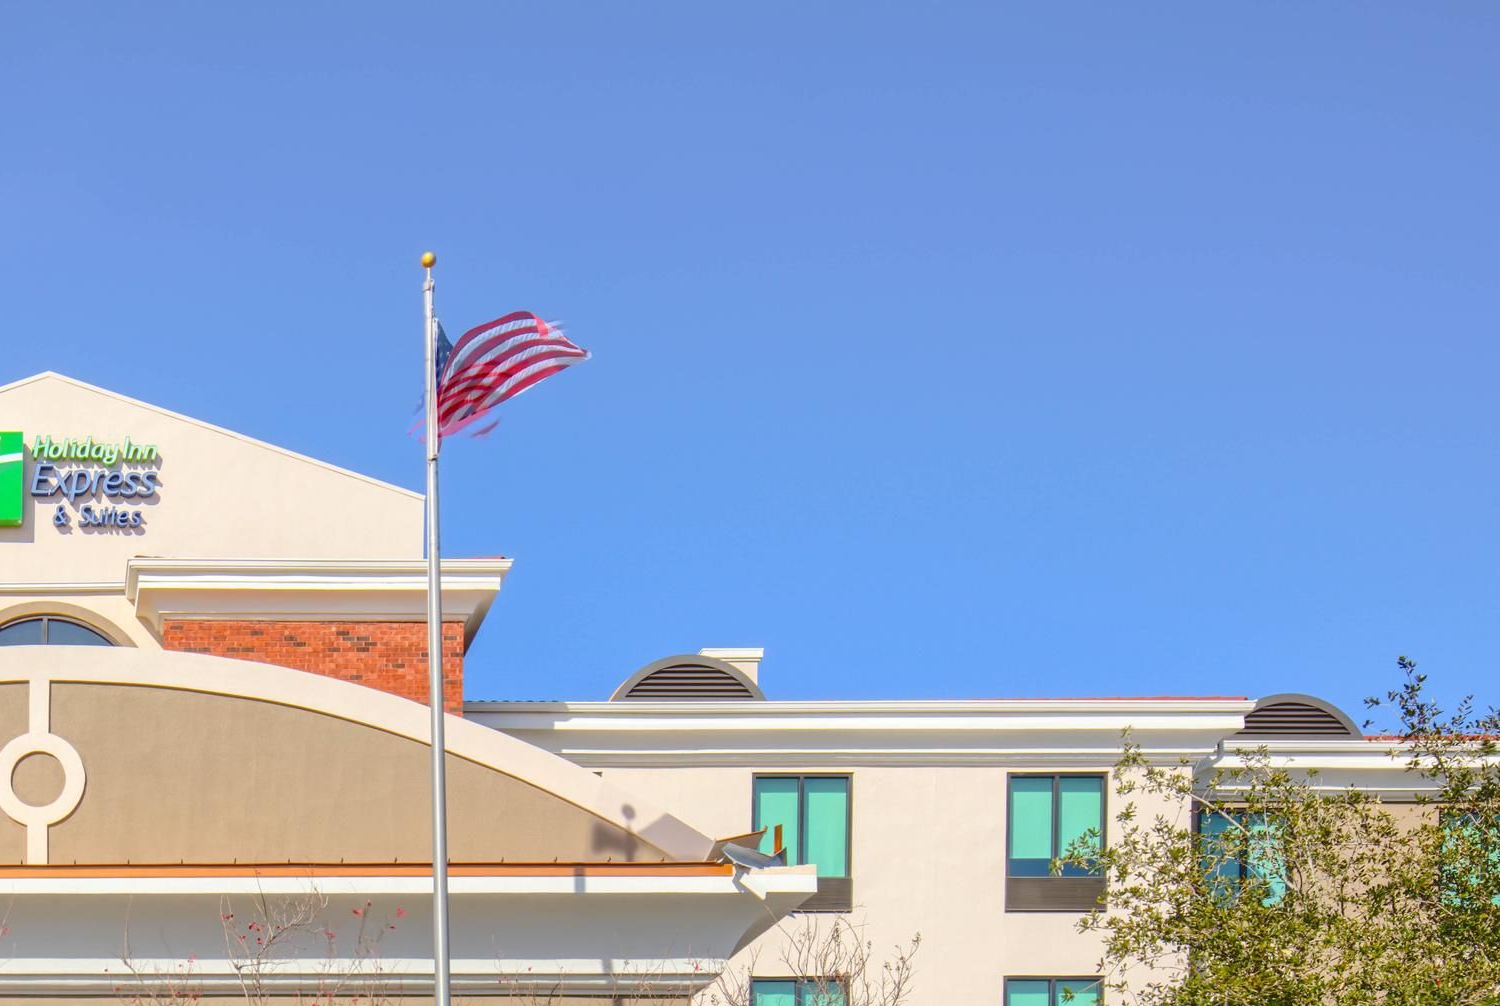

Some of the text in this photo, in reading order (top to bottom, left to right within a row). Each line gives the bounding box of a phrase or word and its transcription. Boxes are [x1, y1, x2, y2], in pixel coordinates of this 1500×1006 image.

[32, 437, 157, 466] Holiday Inn
[31, 462, 158, 503] Express
[53, 505, 142, 528] & Suites
